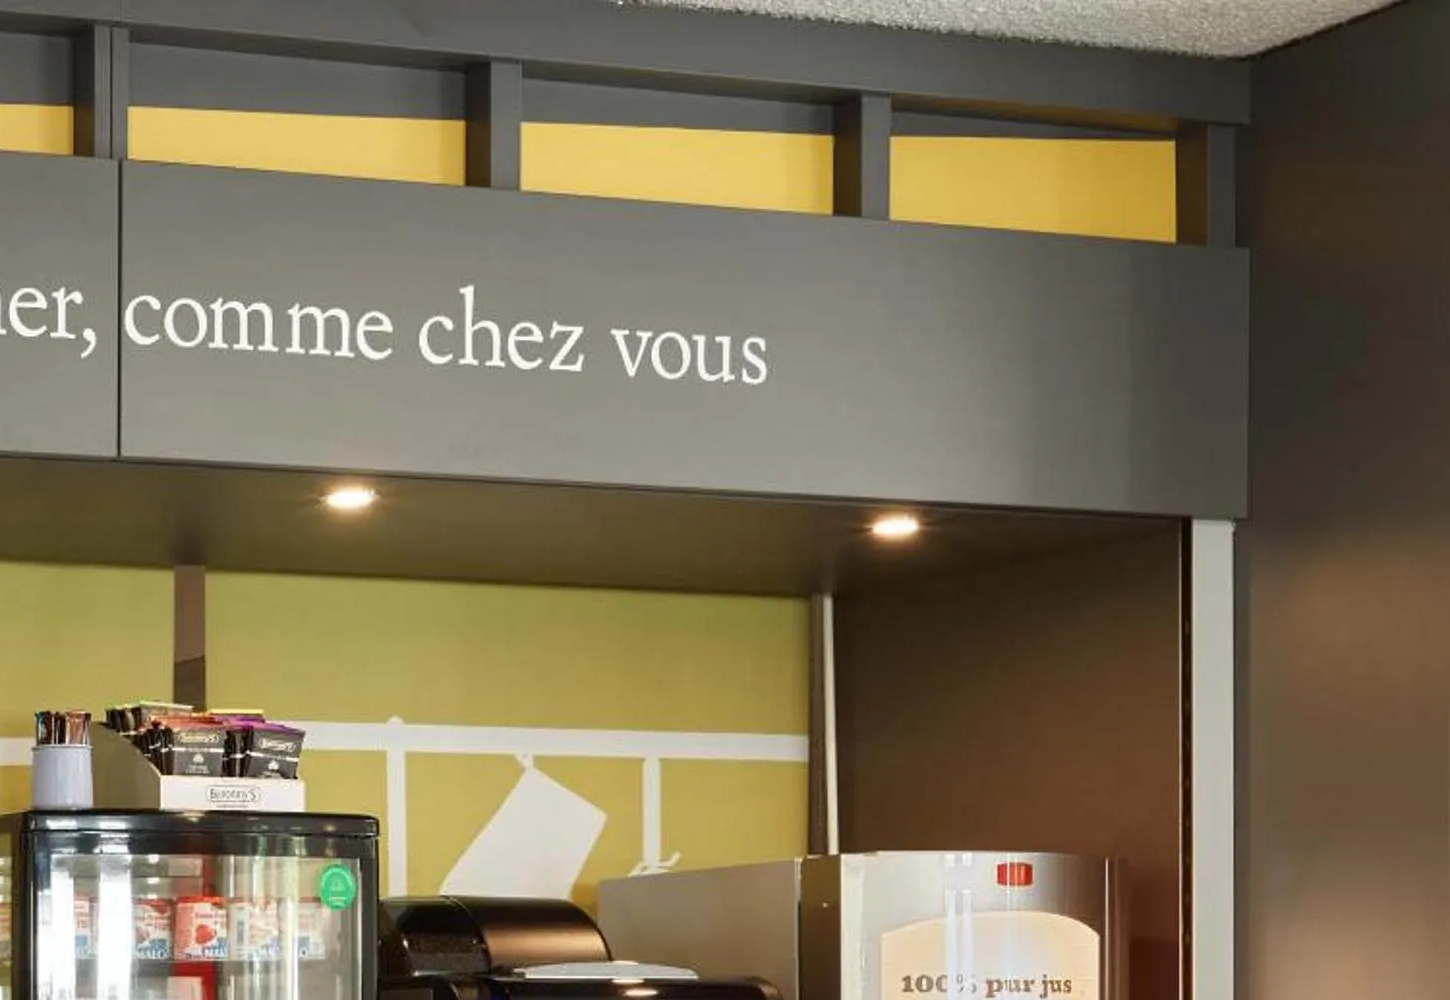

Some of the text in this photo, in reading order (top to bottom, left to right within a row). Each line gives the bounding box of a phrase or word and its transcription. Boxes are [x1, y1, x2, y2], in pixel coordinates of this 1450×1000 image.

[123, 294, 395, 361] comme
[418, 284, 585, 372] chez
[610, 328, 768, 385] vous
[901, 974, 1073, 999] 100% pur jus
